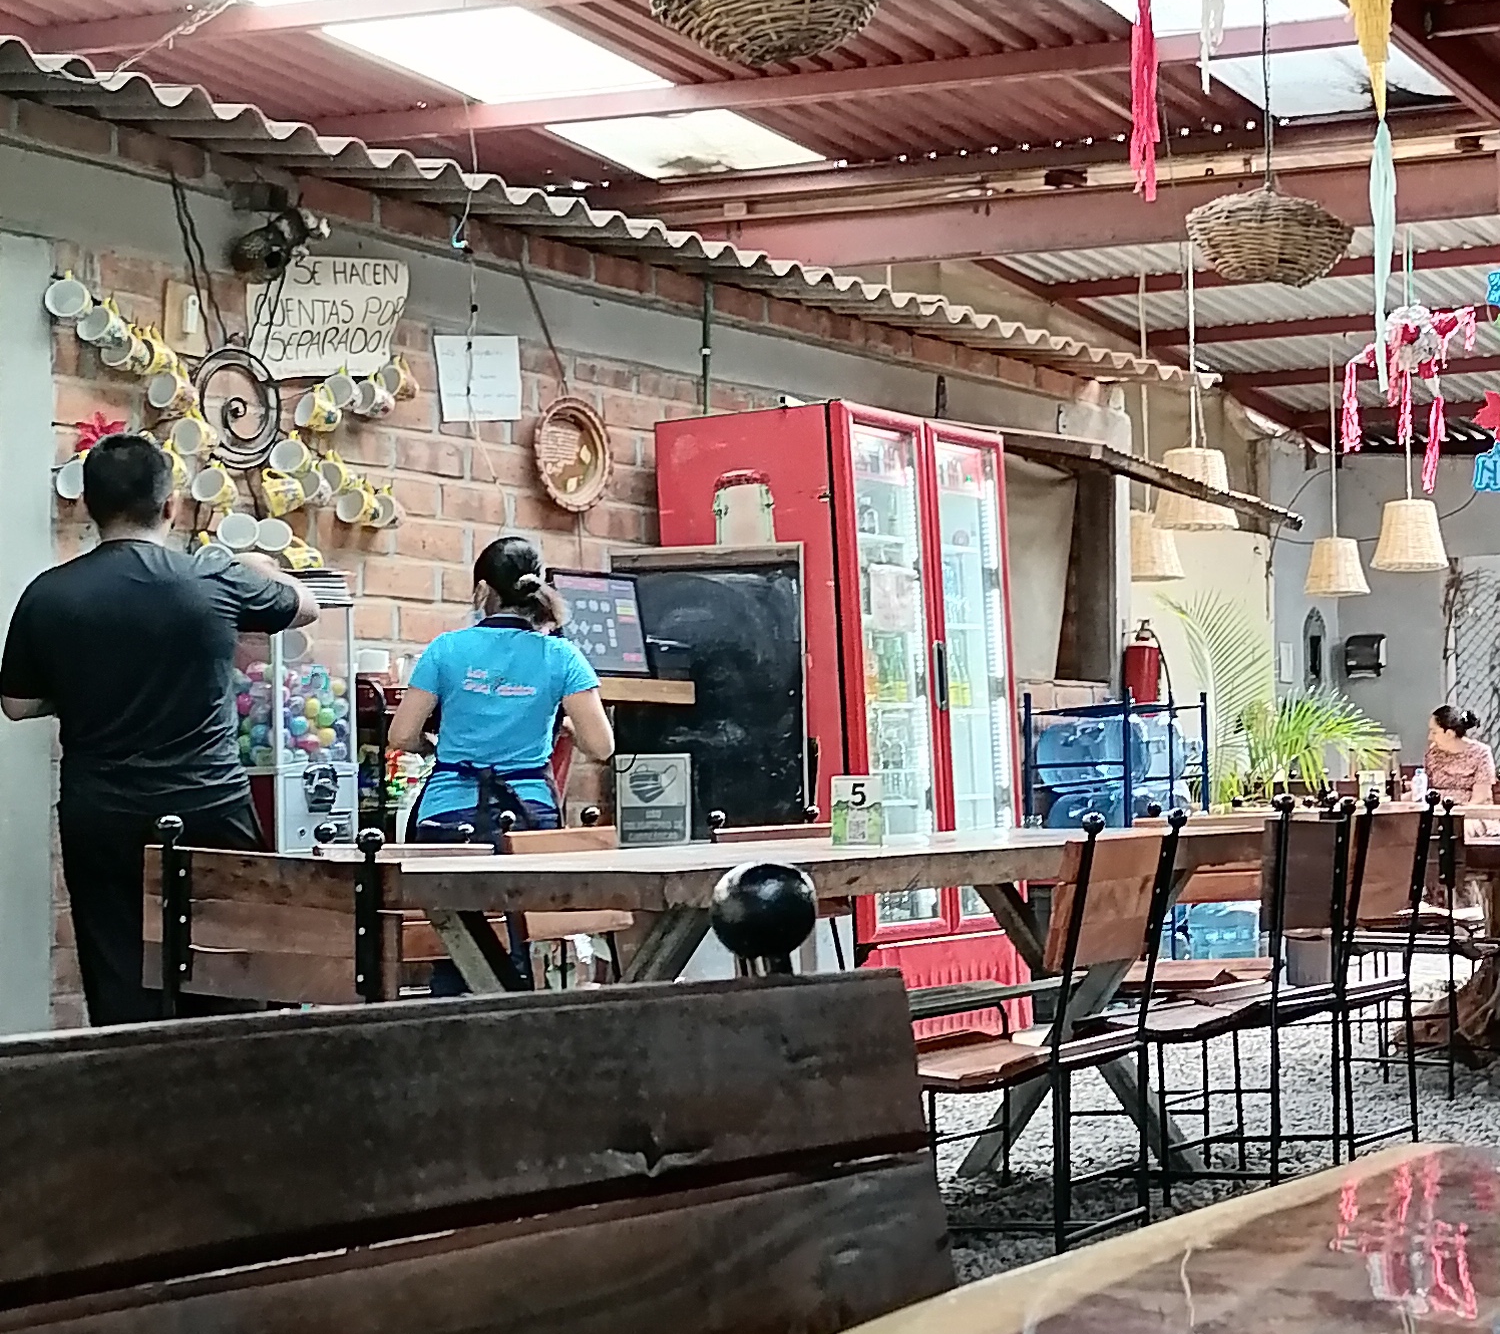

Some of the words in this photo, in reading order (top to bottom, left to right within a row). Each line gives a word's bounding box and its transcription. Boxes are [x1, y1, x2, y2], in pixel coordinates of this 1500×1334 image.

[294, 260, 322, 286] SE
[333, 260, 398, 286] HACEN
[254, 293, 354, 328] CUENTAS
[266, 326, 391, 362] SEPARADO!
[851, 782, 866, 806] 5
